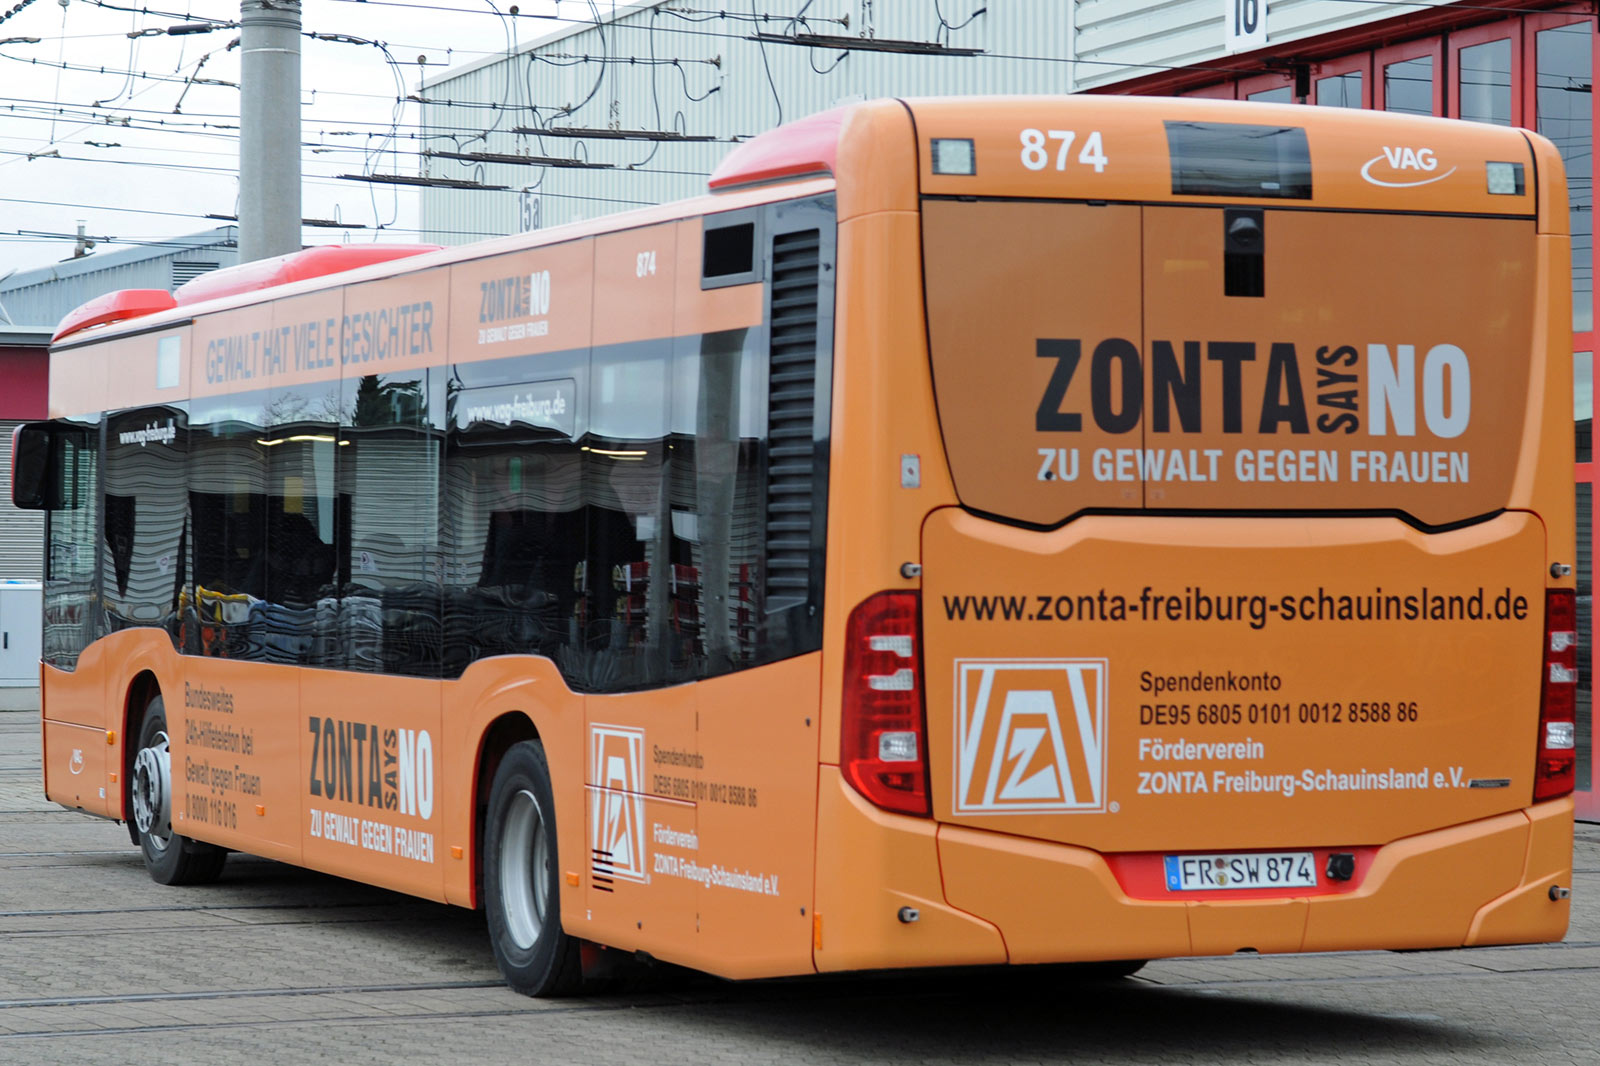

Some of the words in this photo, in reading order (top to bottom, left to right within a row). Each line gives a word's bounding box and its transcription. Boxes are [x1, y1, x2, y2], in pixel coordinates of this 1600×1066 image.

[1020, 128, 1108, 172] 874
[1382, 146, 1438, 171] VAG
[518, 192, 540, 233] 15a
[636, 250, 656, 278] 874
[479, 276, 522, 323] ZONTA
[530, 270, 550, 316] NO
[206, 332, 260, 384] GEWALT
[262, 326, 290, 376] HAT
[294, 319, 335, 372] VIELE
[340, 301, 433, 366] GESICHTER
[1035, 337, 1310, 434] ZONTA
[1316, 345, 1359, 434] SAYS
[1367, 343, 1471, 438] NO
[466, 390, 566, 427] www.vag-freiburg.de
[1037, 448, 1080, 482] ZU
[1092, 449, 1223, 482] GEWALT
[1235, 450, 1338, 482] GEGEN
[1351, 451, 1469, 483] FRAUEN
[943, 587, 1528, 629] www.zonta-freiburg-schauinsland.de
[185, 681, 234, 714] Bundesweites
[1140, 671, 1281, 697] Spendenkonto
[1140, 705, 1191, 725] DE95
[1197, 704, 1243, 725] 6805
[1248, 703, 1291, 724] 0101
[1299, 703, 1342, 724] 0012
[1348, 702, 1391, 723] 8588
[1396, 702, 1418, 722] 86
[241, 727, 253, 755] bei
[653, 744, 704, 770] Spendenkonto
[1138, 737, 1264, 760] Förderverein
[185, 755, 209, 786] Gewalt
[211, 766, 233, 795] gegen
[234, 765, 261, 796] Frauen
[309, 716, 383, 809] ZONTA
[384, 729, 397, 811] SAYS
[398, 728, 434, 820] NO
[1137, 771, 1210, 794] ZONTA
[1213, 767, 1429, 796] Freiburg-Schauinsland
[1433, 766, 1466, 788] e.V.
[310, 808, 322, 838] ZU
[324, 811, 359, 846] GEWALT
[361, 819, 392, 854] GEGEN
[394, 826, 434, 864] FRAUEN
[653, 823, 698, 850] Förderverein
[653, 853, 680, 877] ZONTA
[680, 858, 763, 893] Freiburg-Schauinsland
[1182, 860, 1214, 885] FR
[1230, 858, 1259, 883] SW
[1267, 856, 1310, 881] 874
